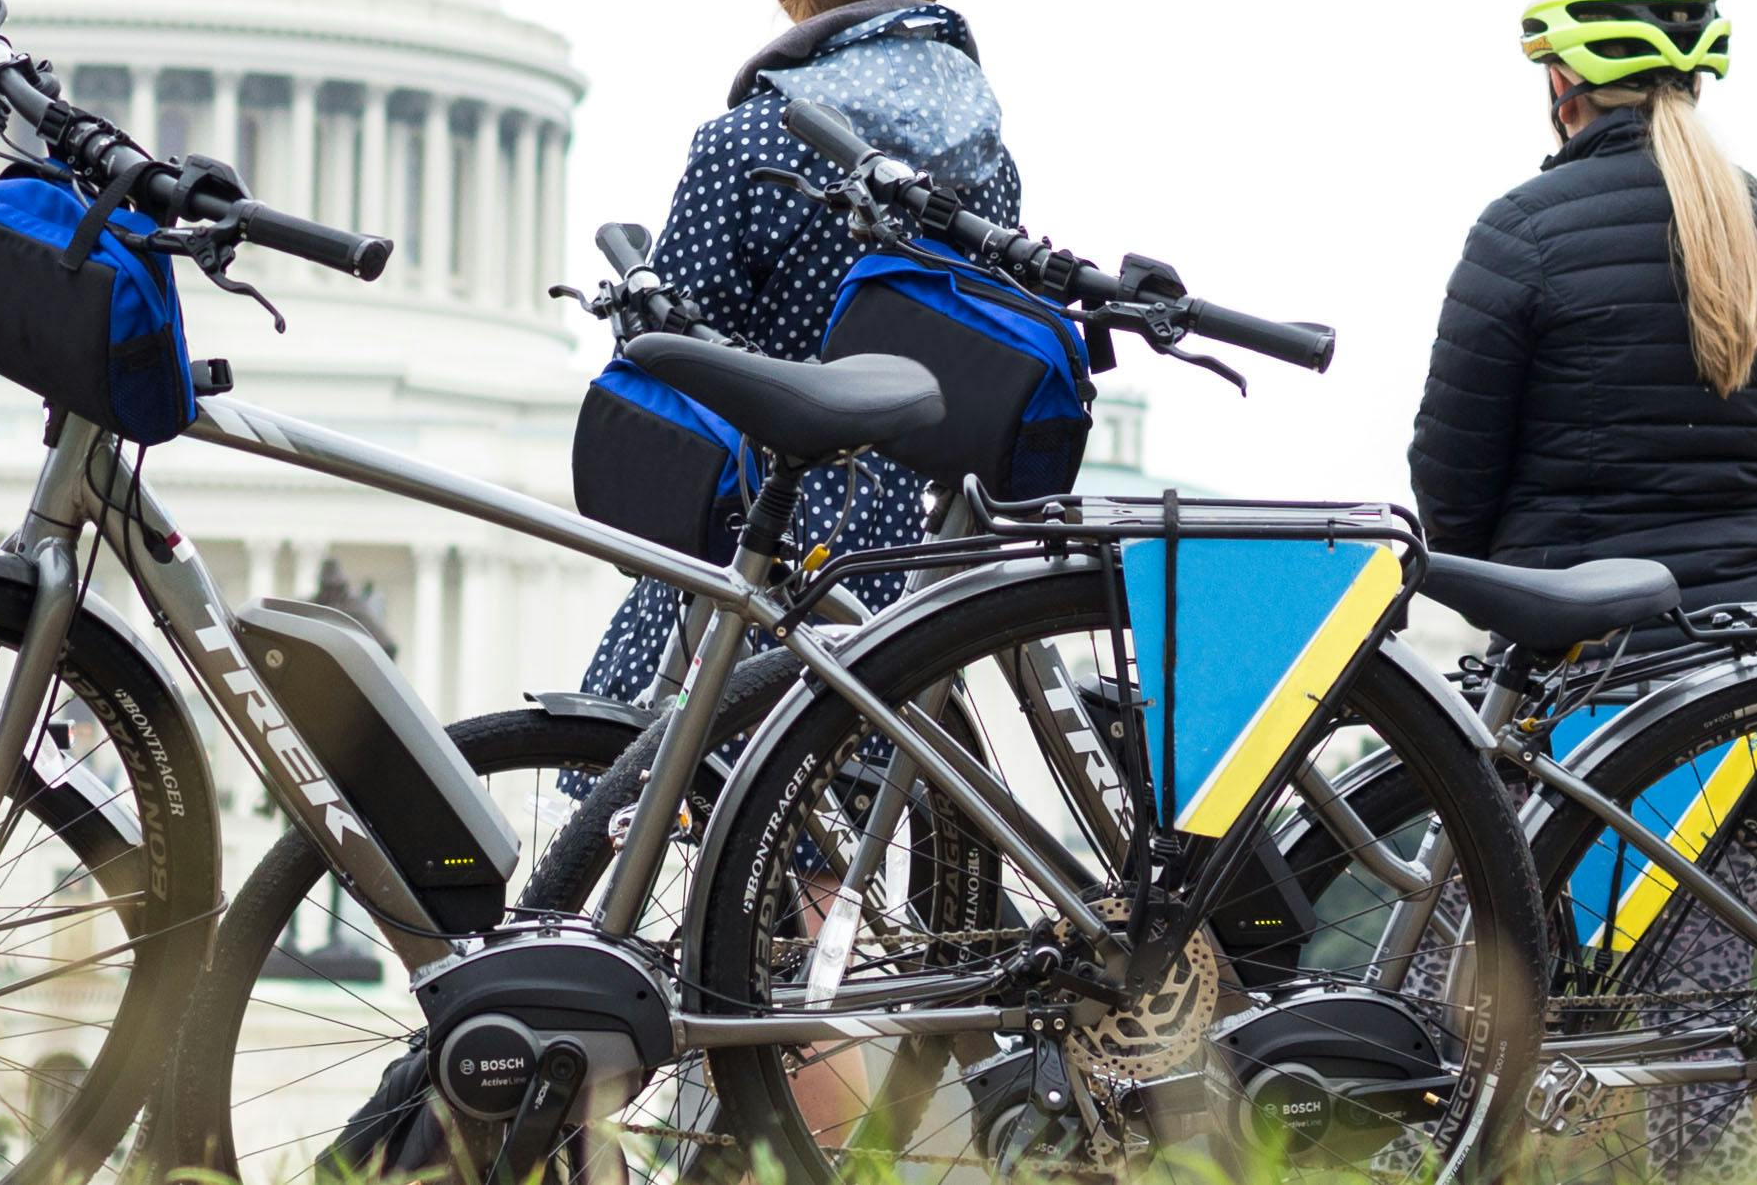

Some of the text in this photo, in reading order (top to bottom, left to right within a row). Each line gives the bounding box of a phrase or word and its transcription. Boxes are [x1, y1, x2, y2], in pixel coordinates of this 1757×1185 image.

[123, 702, 185, 818] BONTRAGER
[195, 603, 368, 847] TREK
[1044, 665, 1136, 843] TRE
[745, 752, 818, 897] BONTRAGER
[479, 1057, 525, 1072] BOSCH
[1282, 1101, 1321, 1115] BOSCH
[1433, 993, 1493, 1152] NECTION
